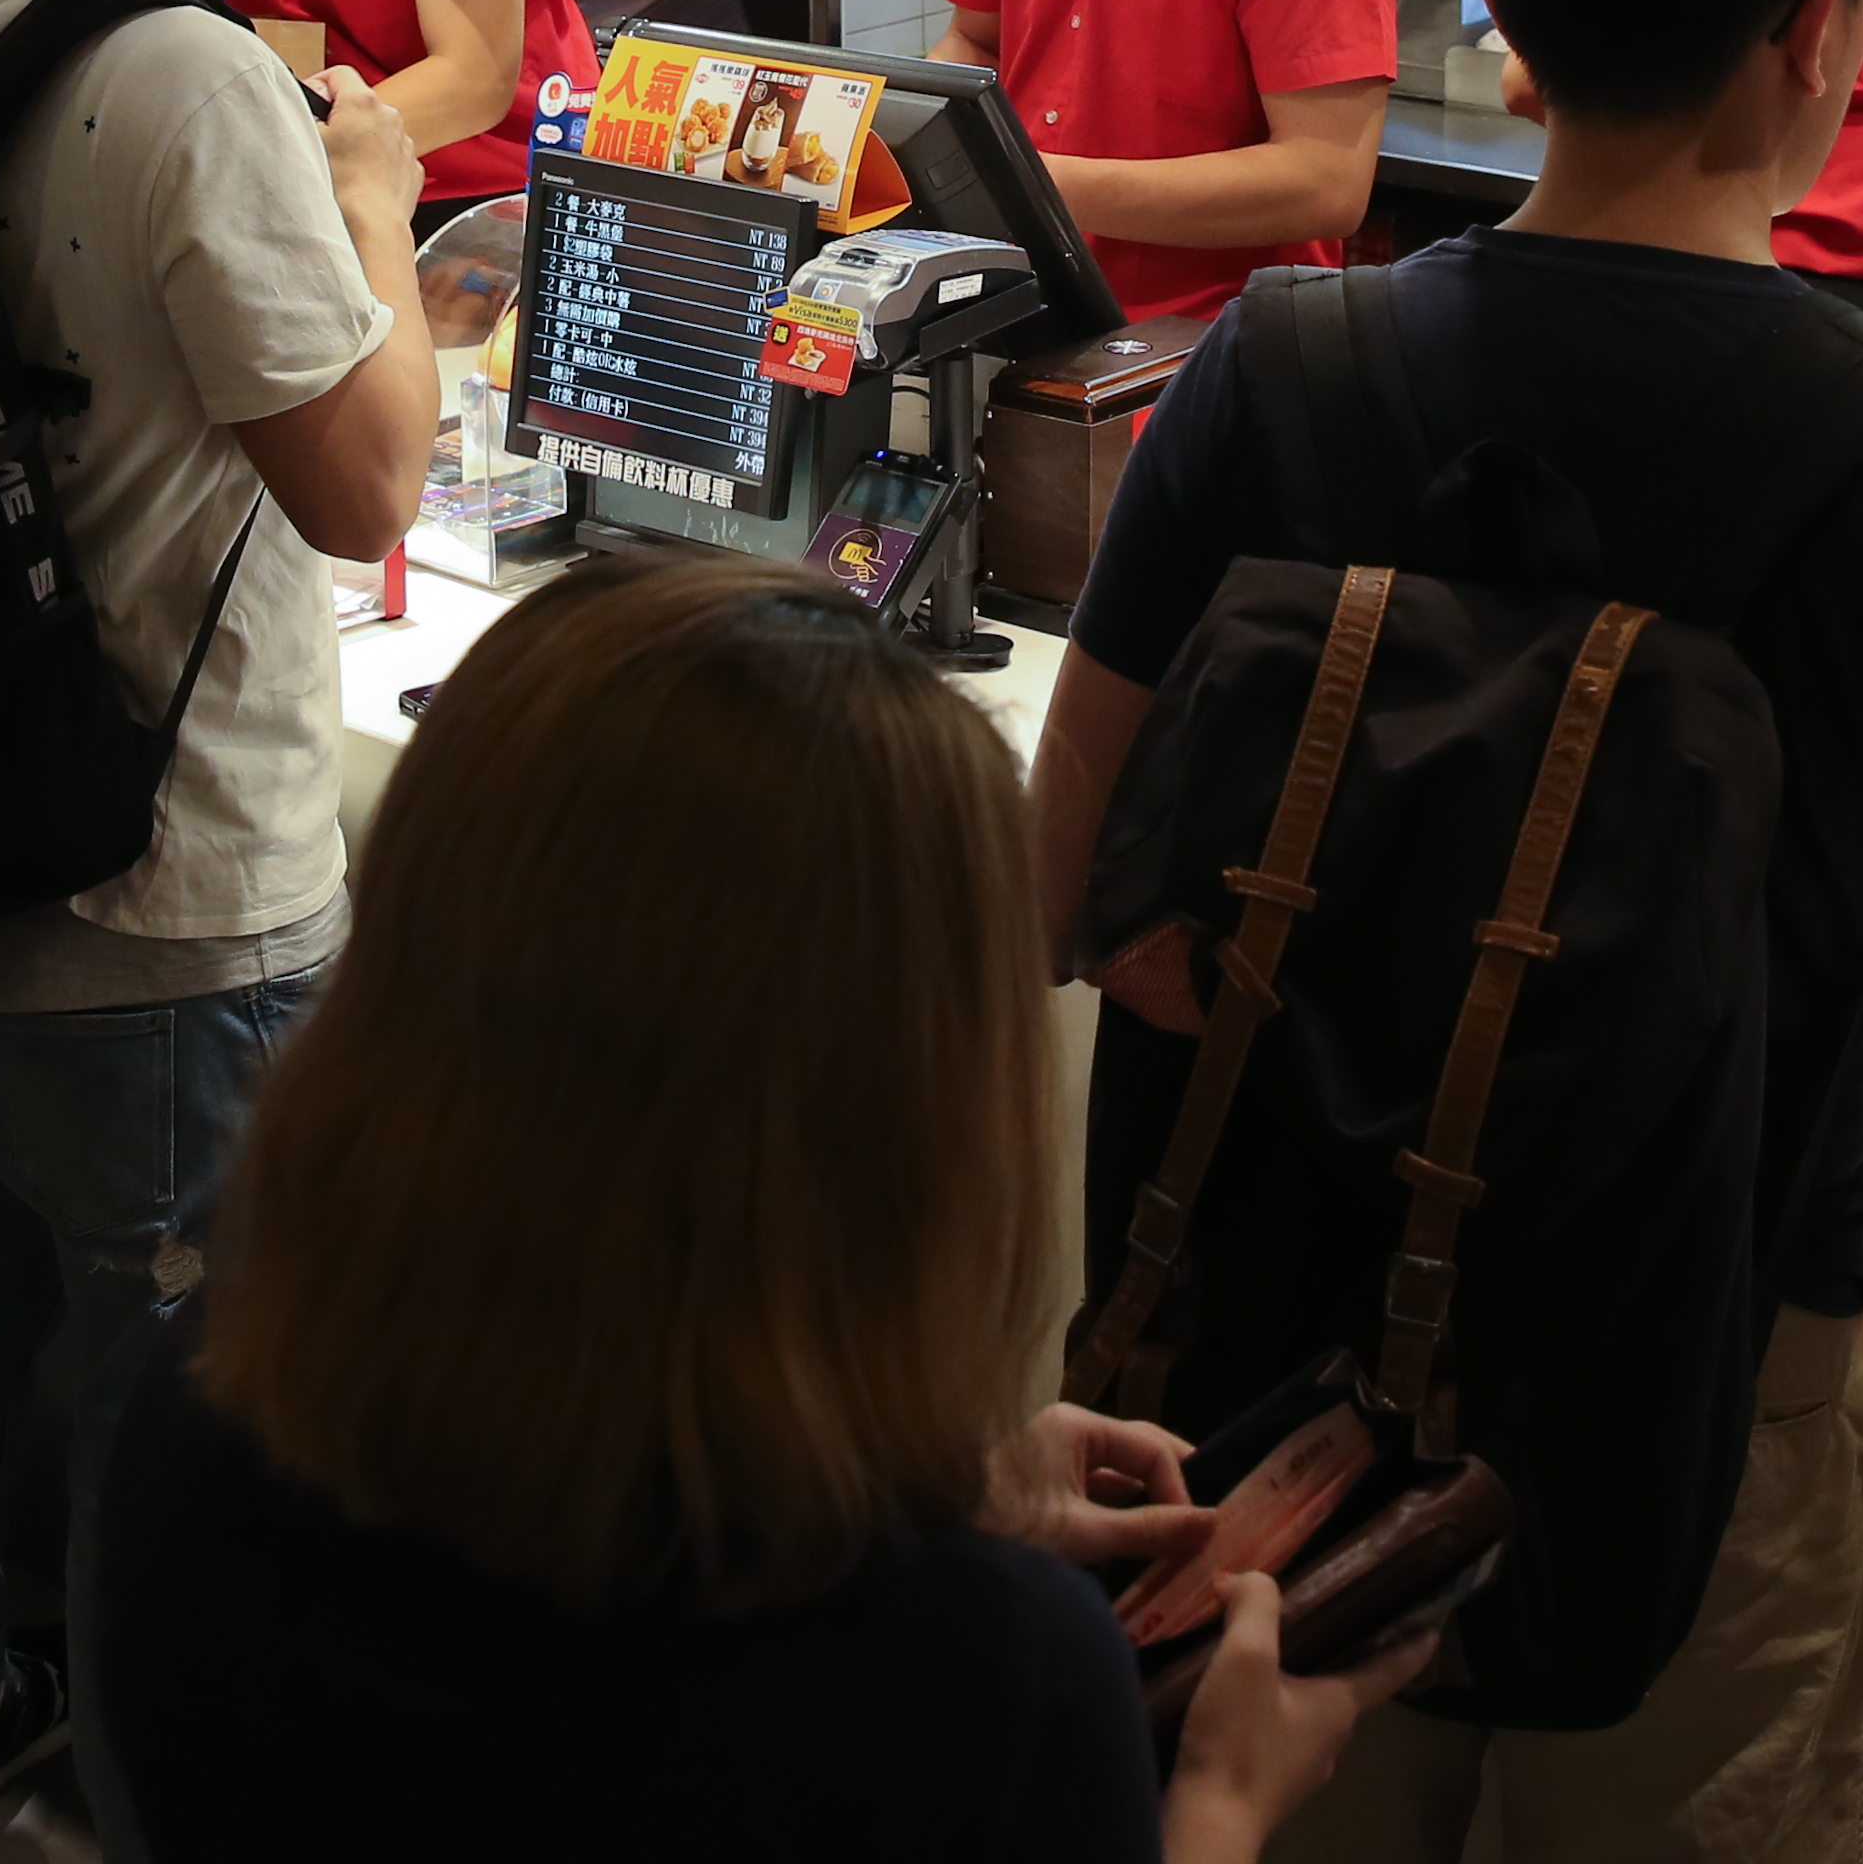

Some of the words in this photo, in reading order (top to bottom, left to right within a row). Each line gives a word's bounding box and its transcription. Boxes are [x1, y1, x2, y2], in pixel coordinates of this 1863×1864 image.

[604, 55, 689, 116] 人氣
[591, 112, 670, 171] 加點
[554, 213, 561, 228] 1
[752, 253, 769, 270] NT
[769, 255, 785, 272] 89
[555, 192, 564, 206] 2
[748, 228, 765, 245] NT
[768, 232, 787, 250] 138
[549, 255, 557, 270] 2
[560, 259, 620, 284] 玉米湯-小
[748, 296, 763, 313] NT
[552, 235, 558, 249] 1
[756, 275, 772, 291] NT
[544, 298, 553, 312] 3
[544, 319, 550, 333] 1
[547, 277, 555, 291] 2
[746, 318, 762, 335] NT
[542, 340, 548, 354] 1
[739, 384, 755, 400] NT
[758, 388, 772, 405] 32
[729, 427, 745, 442] NT
[747, 431, 767, 449] 394
[731, 405, 747, 421] NT
[750, 409, 769, 426] 394
[537, 434, 734, 509] 提供自備飲料杯優惠
[735, 452, 765, 476] 外帶
